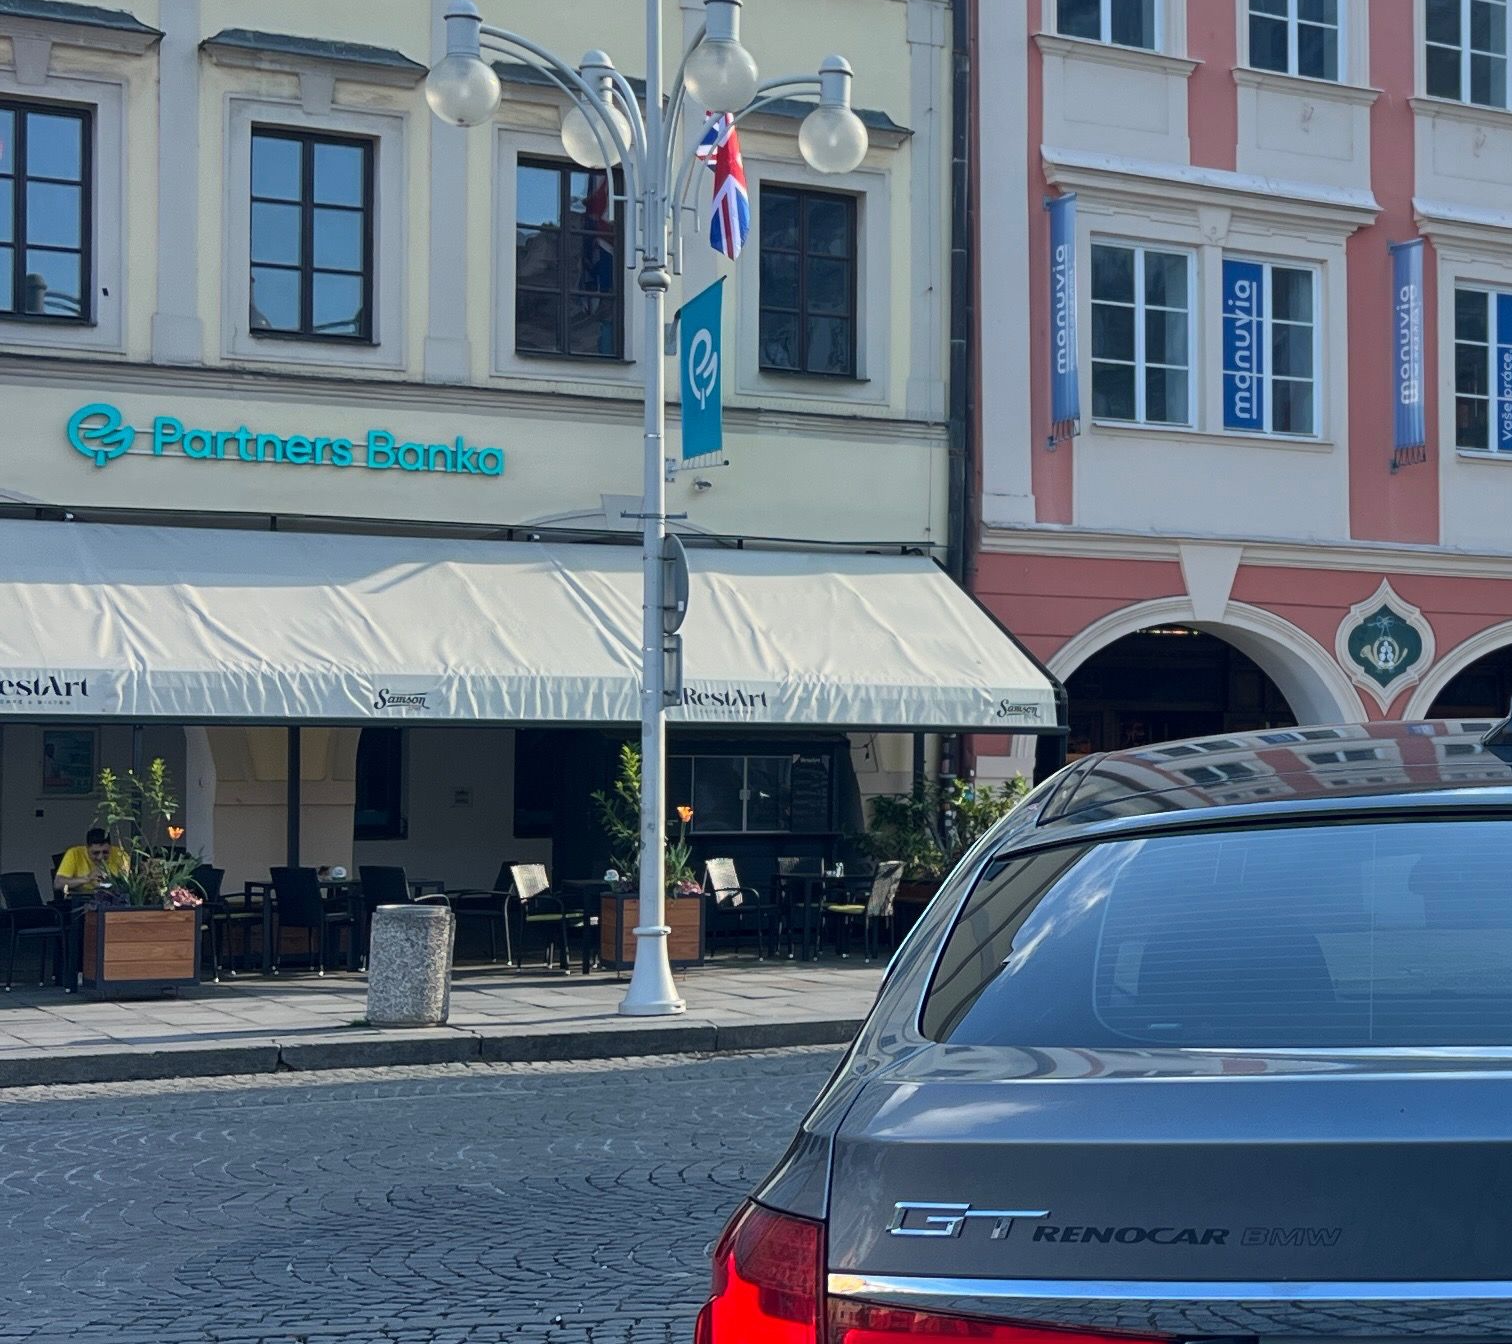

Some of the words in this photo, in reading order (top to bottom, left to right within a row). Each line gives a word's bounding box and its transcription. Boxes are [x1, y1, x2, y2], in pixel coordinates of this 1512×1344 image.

[1053, 244, 1067, 375] manuvia
[1228, 279, 1251, 419] manuvia
[1396, 285, 1412, 405] manuvia
[153, 416, 354, 468] Partners
[366, 429, 504, 476] Banka
[373, 688, 430, 710] Samson
[682, 687, 768, 707] RestArt
[996, 698, 1041, 718] Samson
[886, 1201, 1051, 1239] GT
[1032, 1226, 1230, 1246] RENOCAR
[1240, 1226, 1342, 1247] BMW
